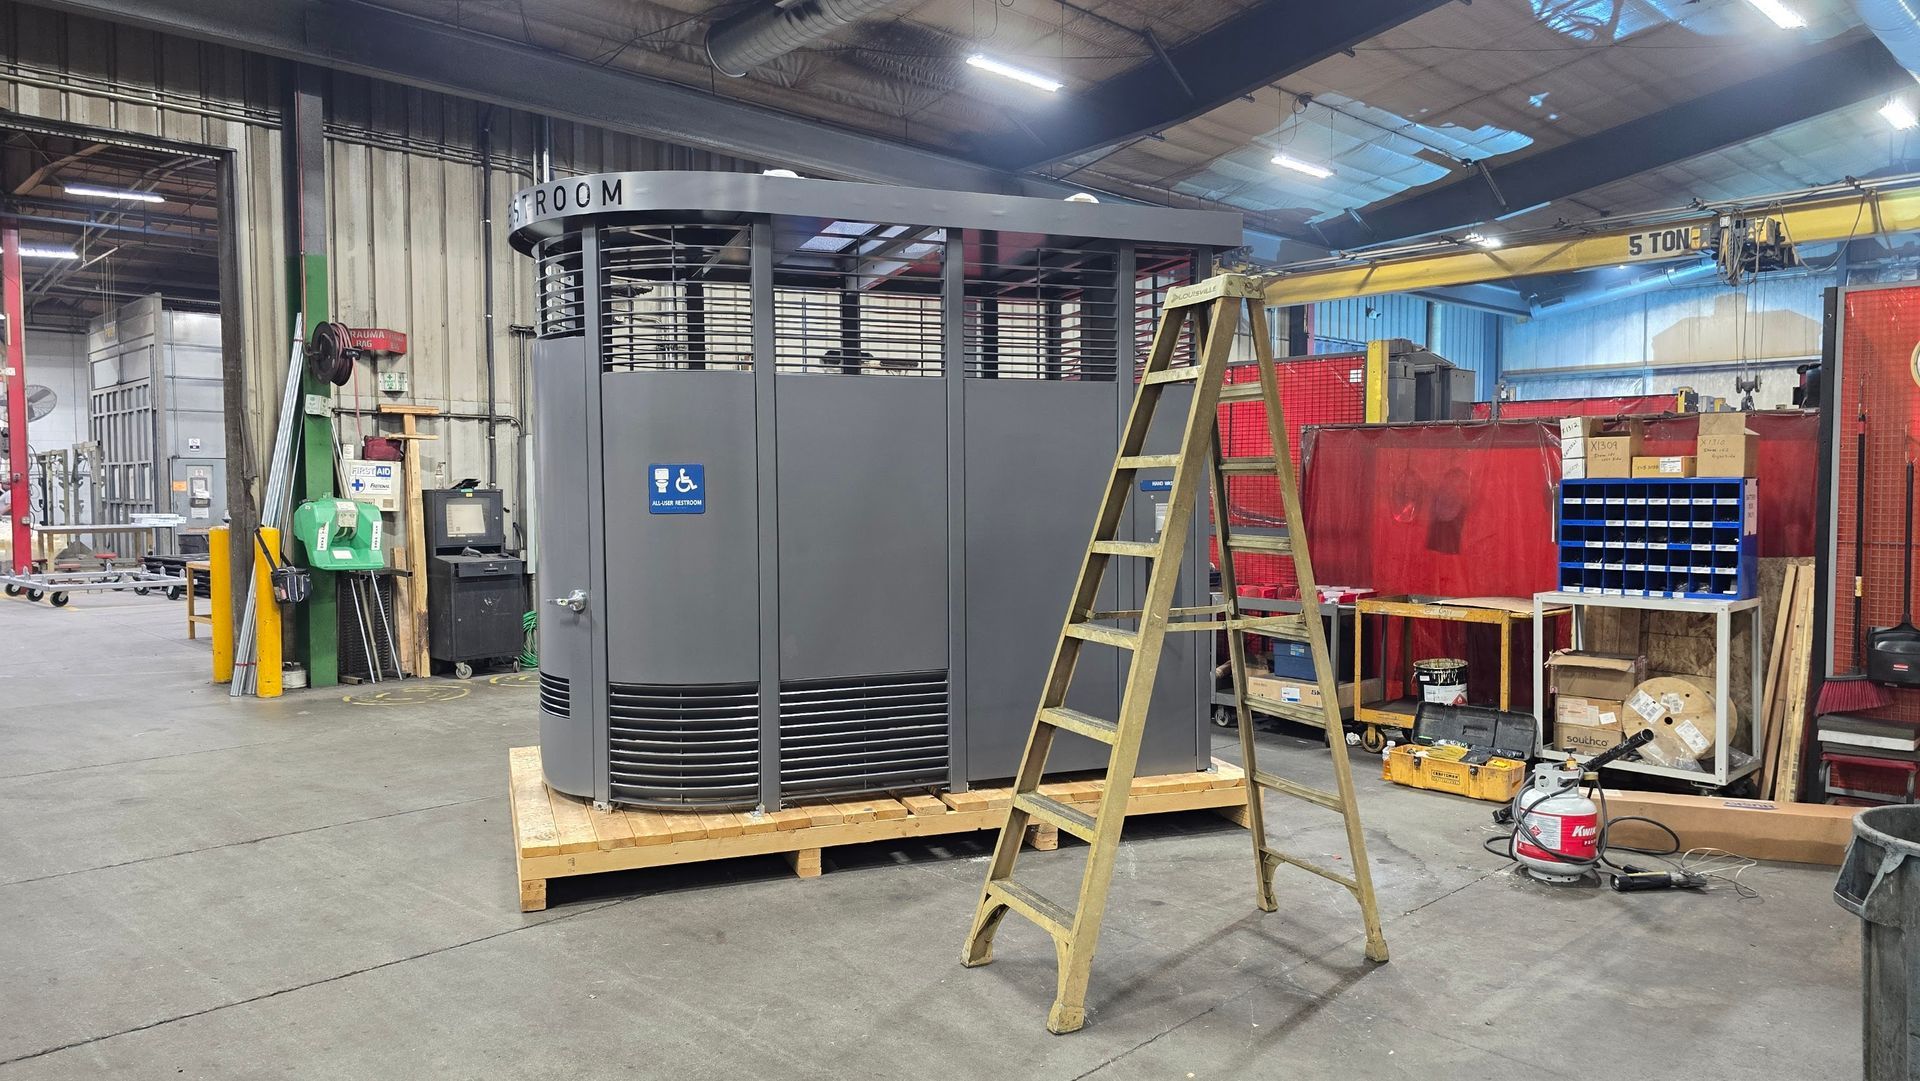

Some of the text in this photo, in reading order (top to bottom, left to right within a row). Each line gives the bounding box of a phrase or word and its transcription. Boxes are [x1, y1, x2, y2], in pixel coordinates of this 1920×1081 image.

[1629, 227, 1690, 256] 5 TON
[1178, 285, 1217, 301] LOUISVILLE
[351, 331, 385, 339] RAUMA
[356, 339, 373, 347] BAG
[1590, 440, 1618, 452] X1309
[352, 466, 391, 476] FIRST AID
[1566, 735, 1608, 747] southco
